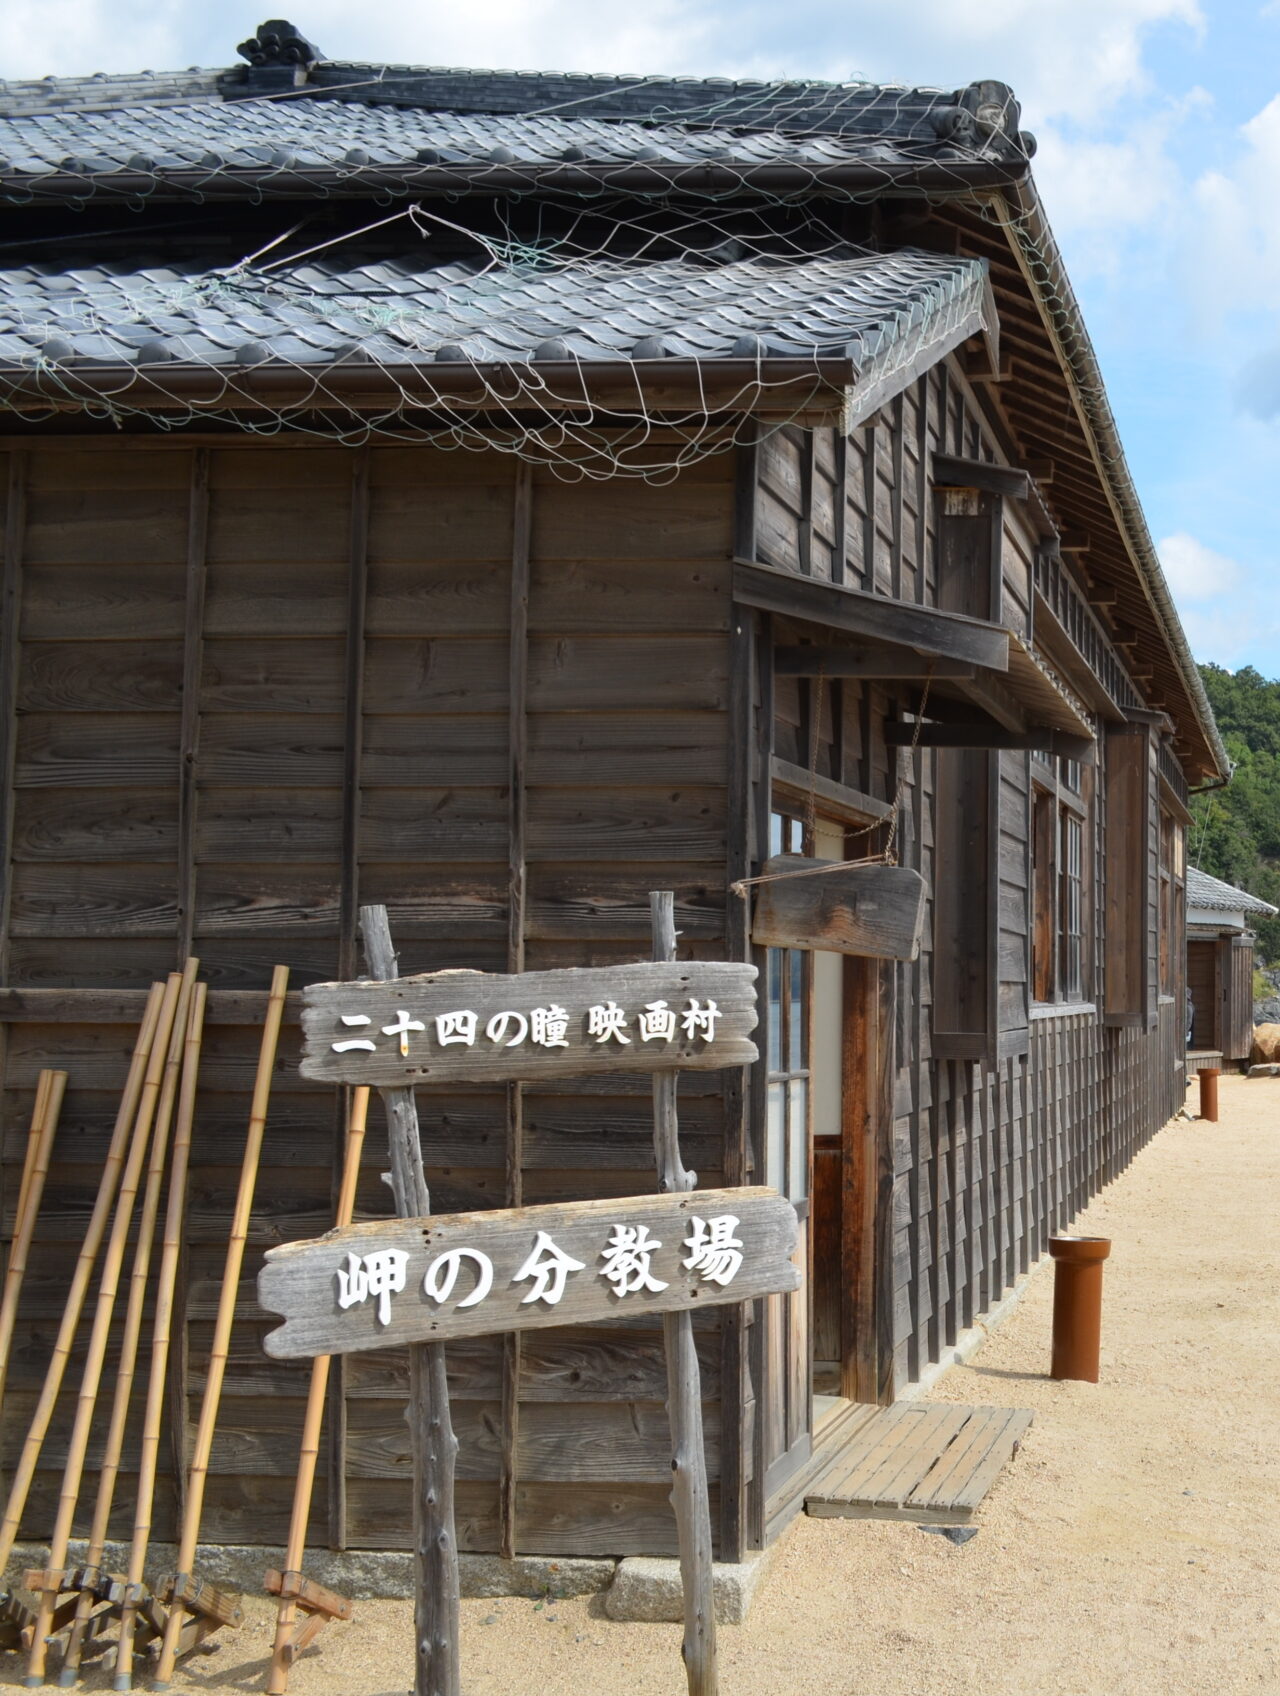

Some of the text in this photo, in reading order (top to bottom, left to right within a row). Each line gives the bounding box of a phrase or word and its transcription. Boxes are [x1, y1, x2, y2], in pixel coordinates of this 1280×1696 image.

[331, 998, 723, 1057] 二十四の瞳 映画村
[337, 1214, 744, 1326] 岬の分教場
